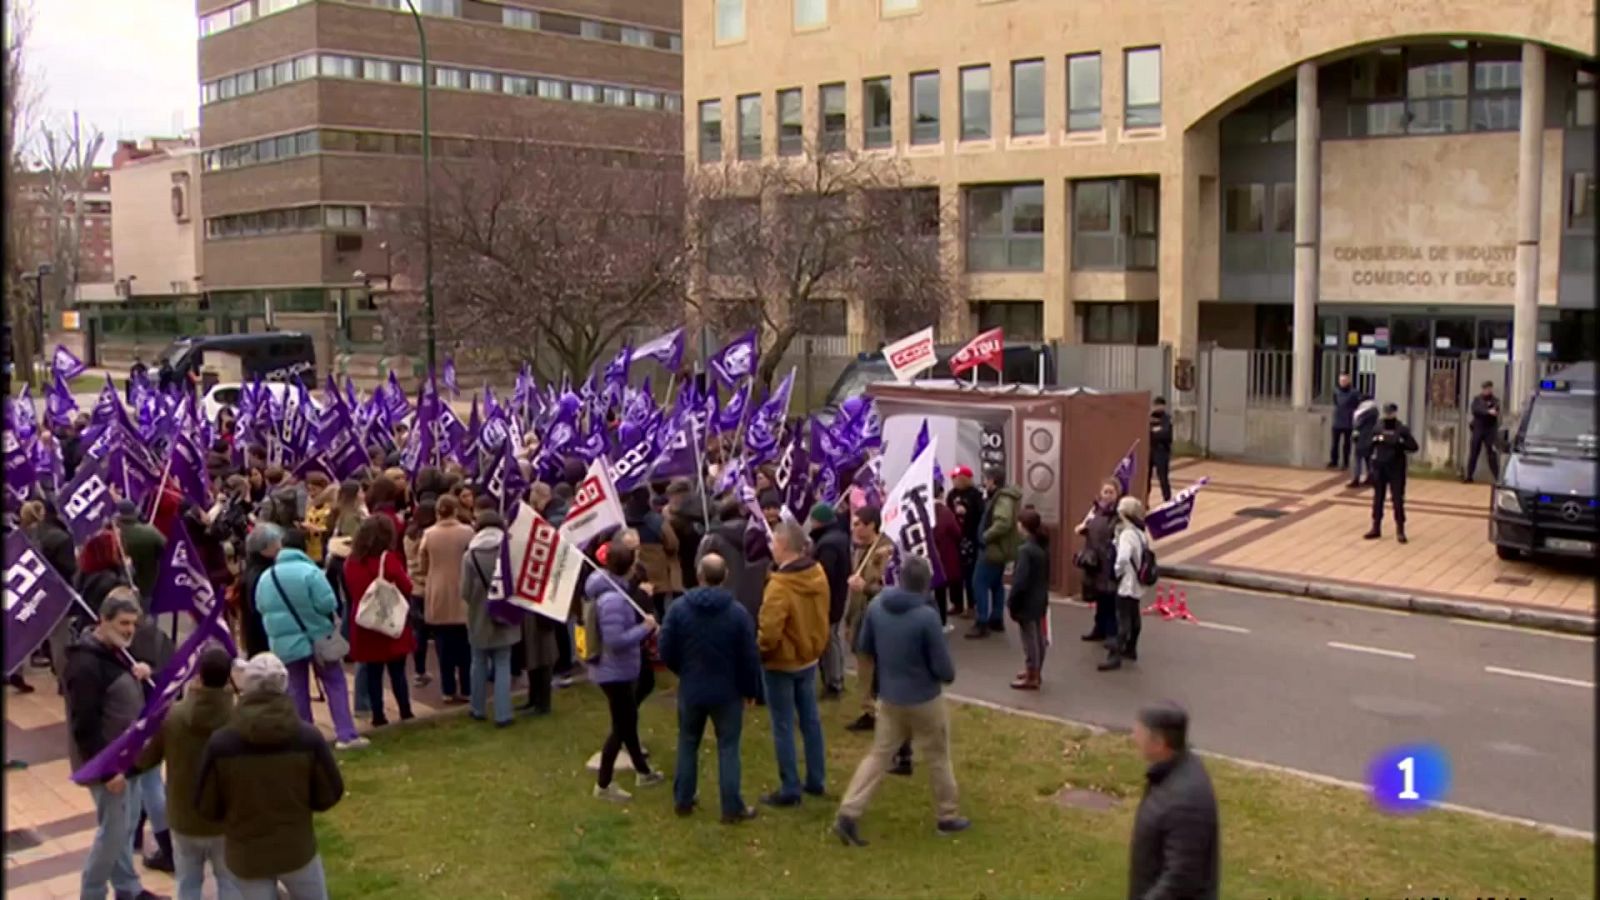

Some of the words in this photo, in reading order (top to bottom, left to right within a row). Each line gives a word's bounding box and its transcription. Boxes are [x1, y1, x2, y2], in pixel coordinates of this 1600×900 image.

[1429, 245, 1449, 261] DE
[1439, 270, 1449, 286] Y
[520, 524, 556, 602] CCOO
